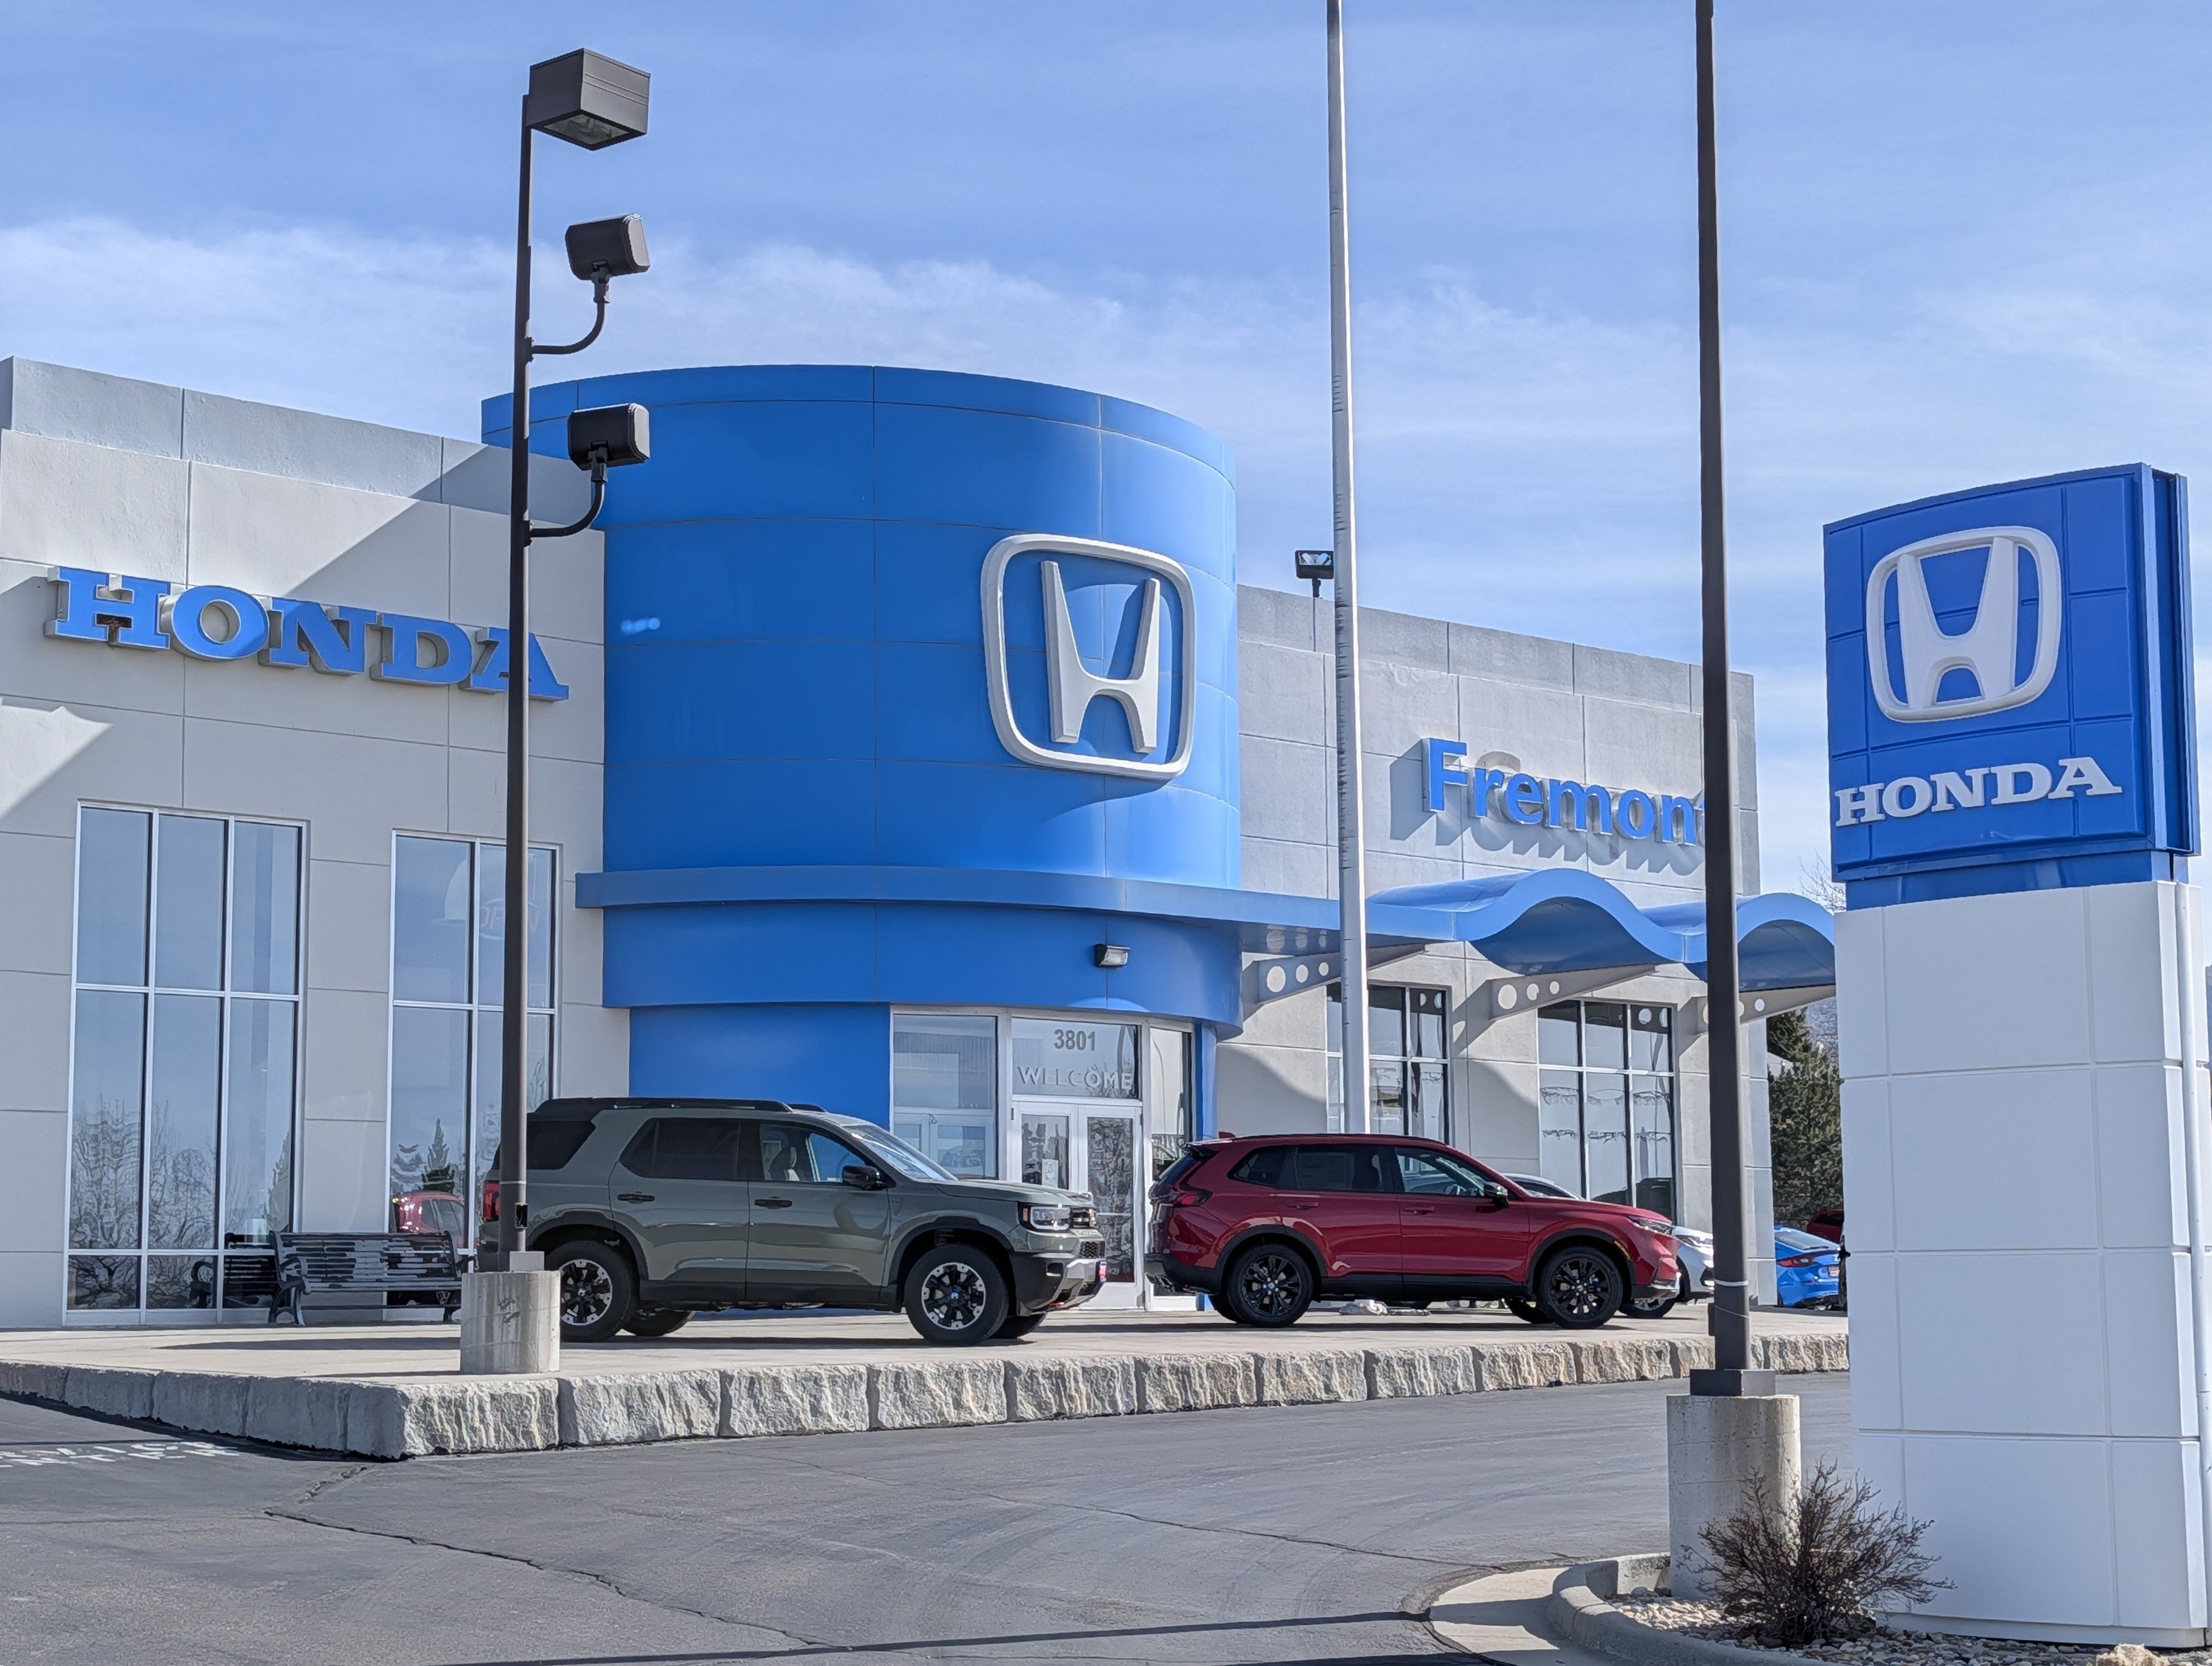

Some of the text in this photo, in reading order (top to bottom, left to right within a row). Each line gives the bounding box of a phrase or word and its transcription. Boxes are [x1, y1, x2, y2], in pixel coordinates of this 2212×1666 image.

[44, 565, 569, 702] HONDA
[1423, 737, 1705, 846] Fremon
[1834, 757, 2122, 827] HONDA
[1053, 1028, 1096, 1052] 3801
[1017, 1066, 1132, 1091] WELCOME
